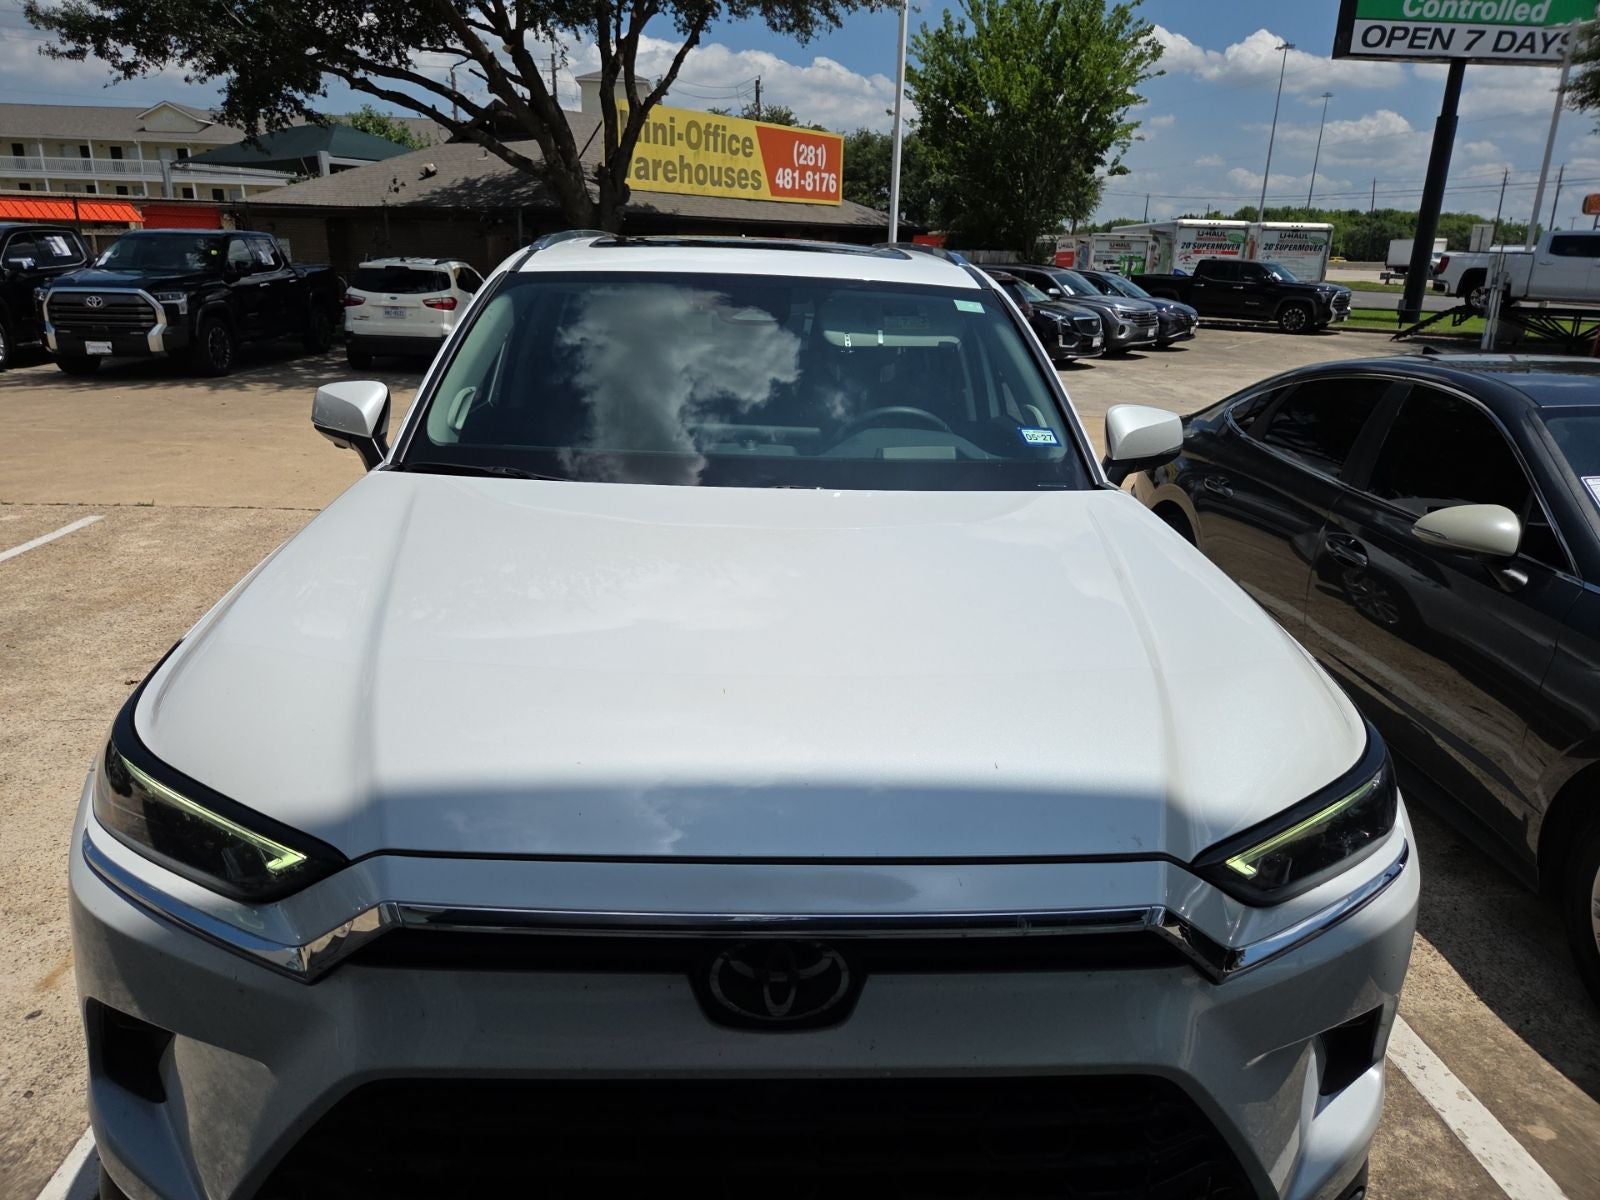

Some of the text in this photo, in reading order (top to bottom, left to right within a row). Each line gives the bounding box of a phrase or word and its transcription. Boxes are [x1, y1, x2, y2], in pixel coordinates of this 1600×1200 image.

[1402, 0, 1551, 23] Controlled
[1361, 25, 1455, 51] OPEN
[1464, 30, 1486, 51] 7
[793, 140, 827, 170] (281)
[627, 155, 762, 191] arehouses
[775, 168, 837, 193] 481-8176
